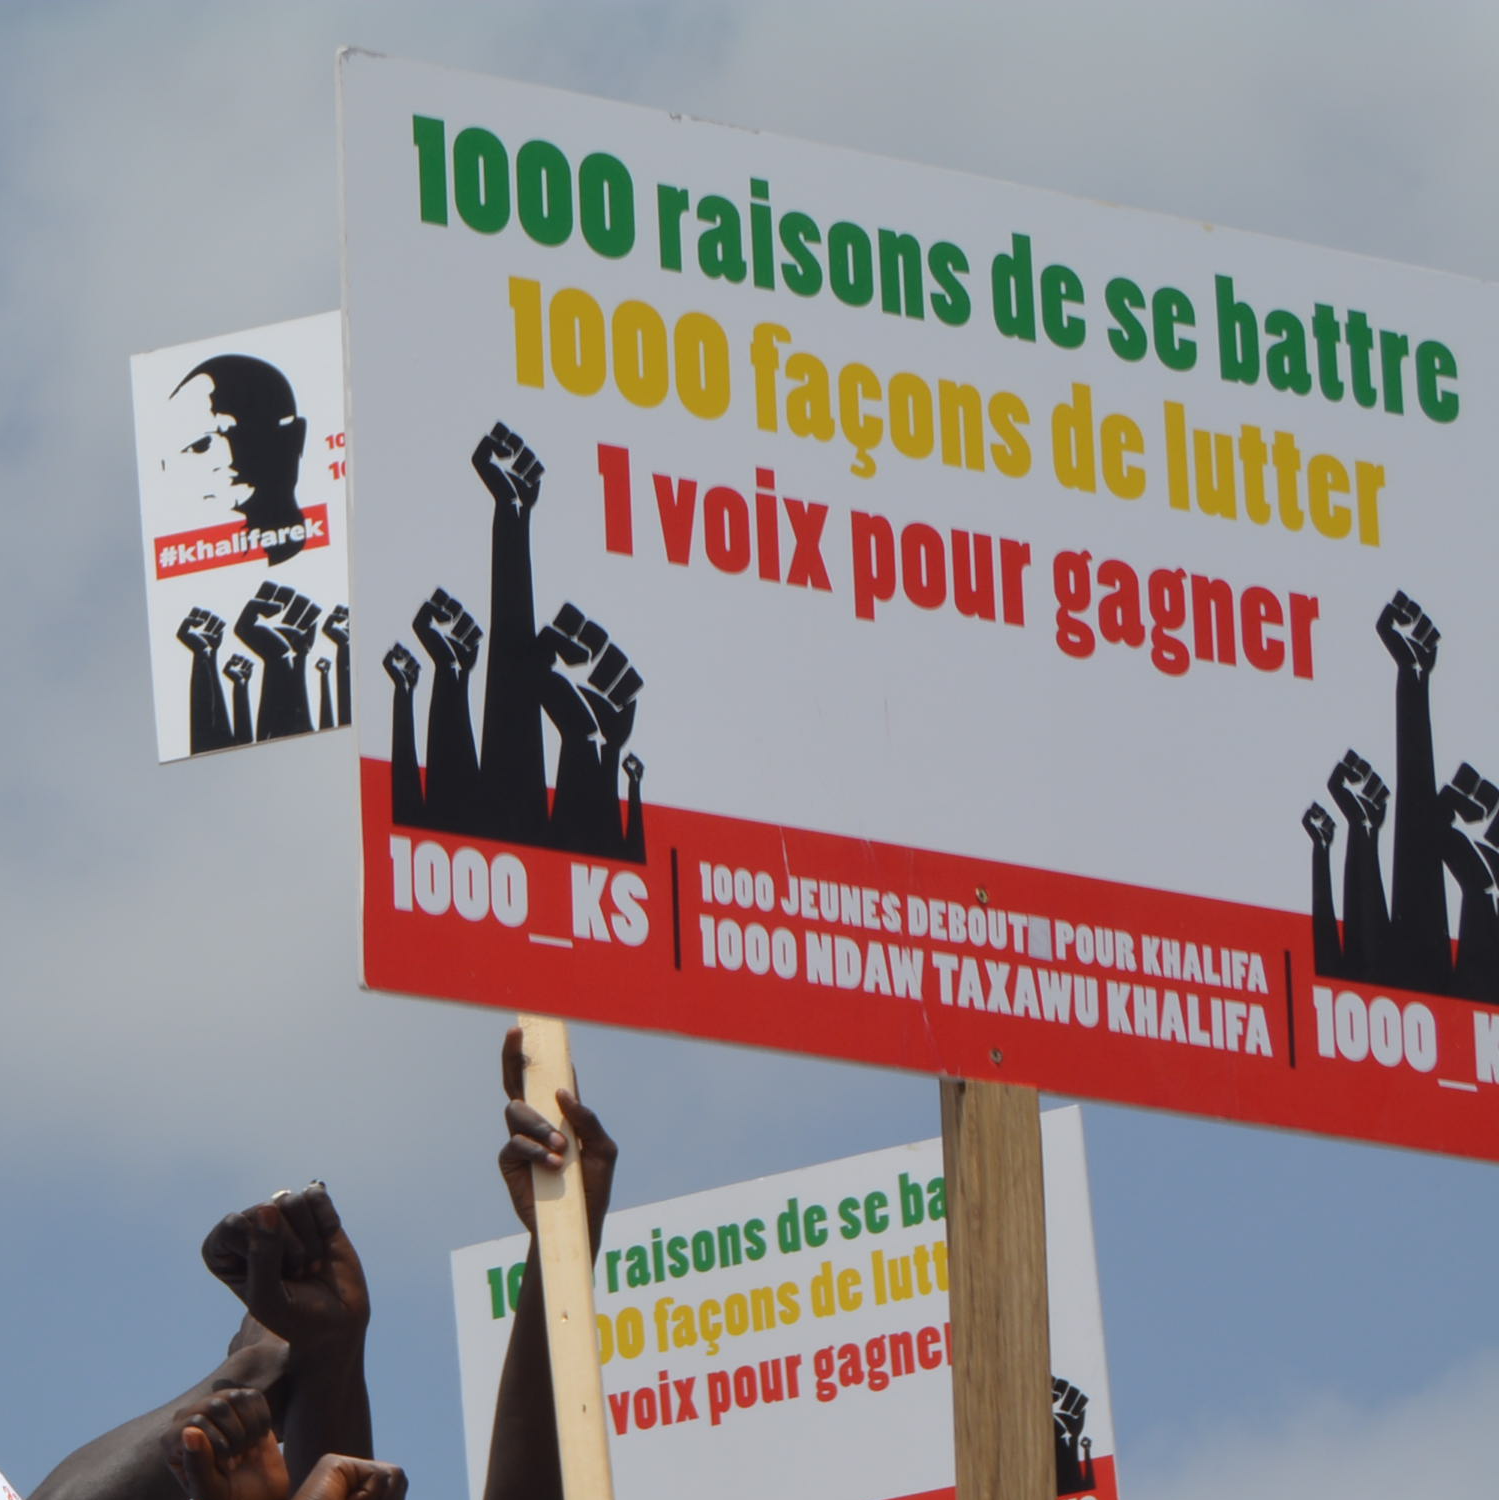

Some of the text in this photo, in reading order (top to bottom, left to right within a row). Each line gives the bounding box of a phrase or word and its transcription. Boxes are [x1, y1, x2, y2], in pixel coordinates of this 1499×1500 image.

[413, 113, 1461, 422] 1000 raisons de se battre
[509, 277, 1385, 546] 1000 façons de lutter
[159, 518, 324, 568] #khalifarek
[598, 445, 1319, 679] 1 voix pour gagner
[391, 836, 649, 947] 1000_KS
[701, 863, 775, 912] 1000
[782, 876, 902, 932] JEUNES
[1055, 920, 1137, 971] POUR
[1142, 936, 1268, 993] KHALIFA
[700, 915, 1272, 1056] 1000 NDAW TAXAWU KHALIFA
[1313, 985, 1499, 1092] 1000_K
[607, 1218, 768, 1292] raisons
[778, 1197, 829, 1252] de
[838, 1190, 890, 1238] se
[654, 1282, 801, 1356] façons
[811, 1262, 863, 1318] de
[871, 1241, 949, 1304] lutt
[609, 1371, 698, 1435] voix
[708, 1356, 801, 1424] pour
